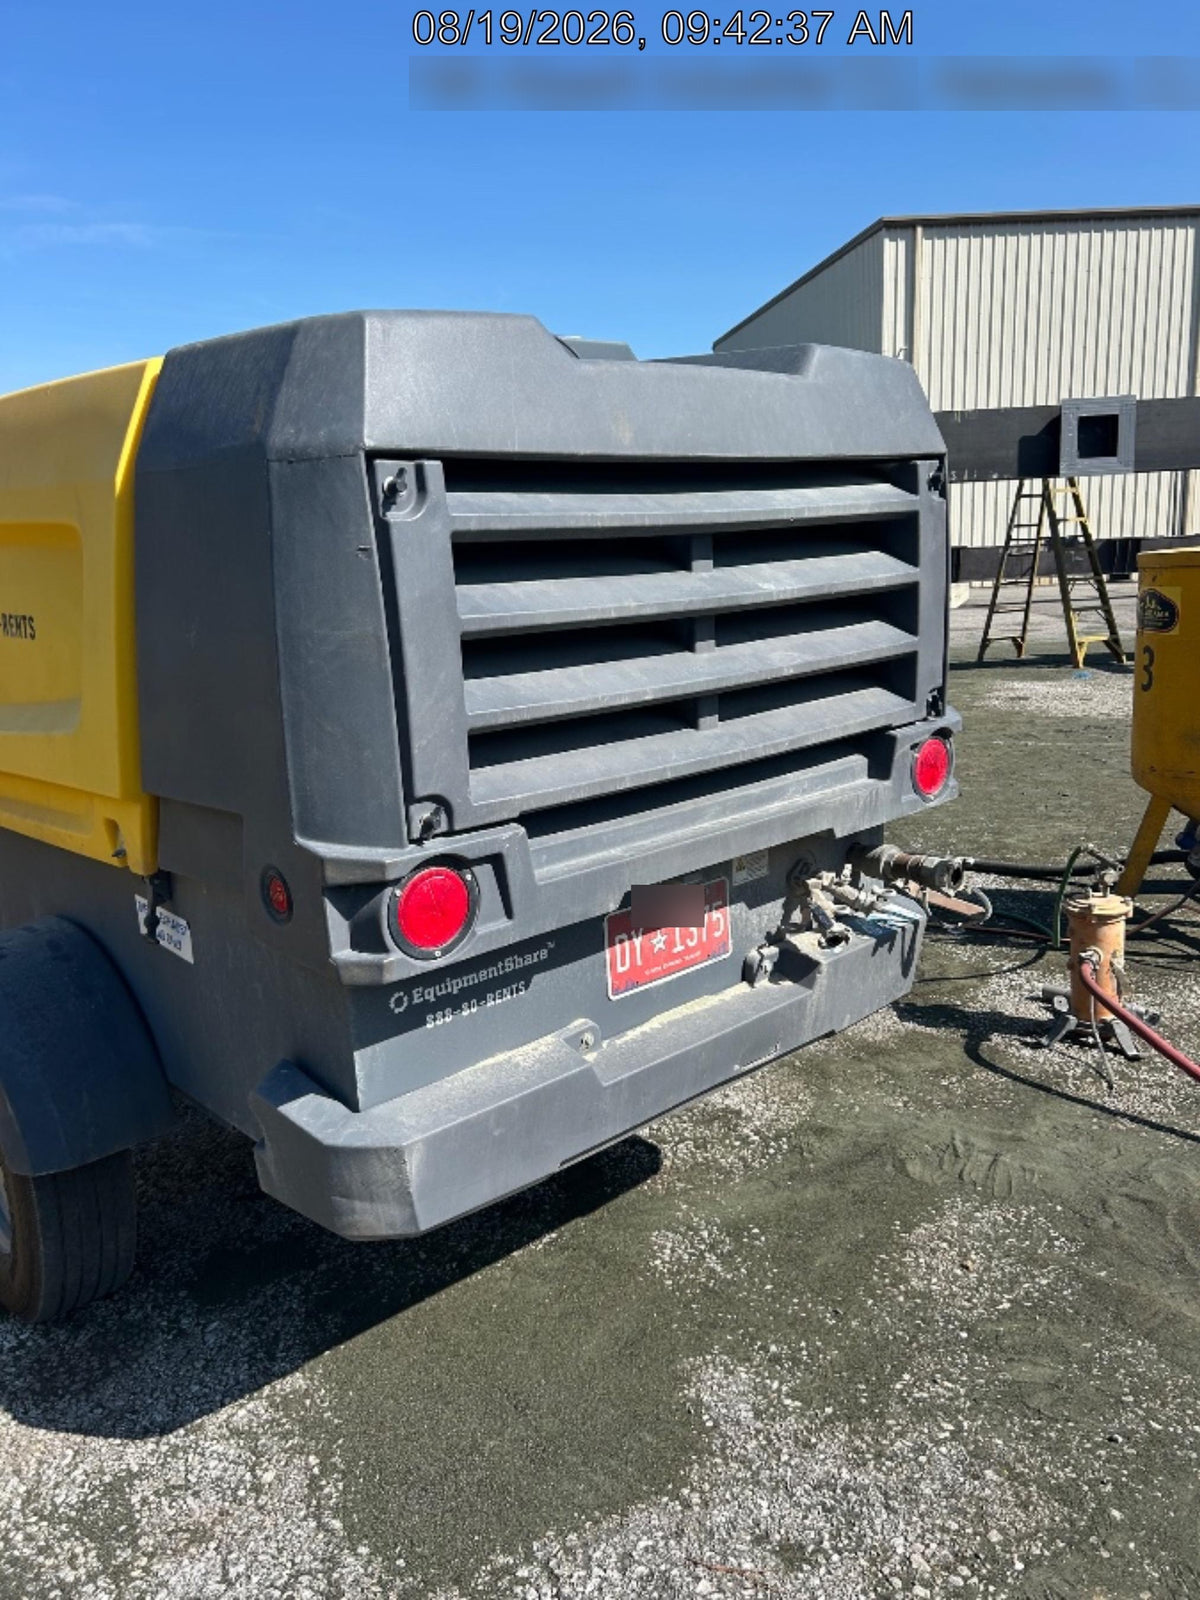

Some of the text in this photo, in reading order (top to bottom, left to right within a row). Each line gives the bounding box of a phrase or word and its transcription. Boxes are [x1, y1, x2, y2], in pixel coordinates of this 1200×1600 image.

[1140, 645, 1155, 692] 3
[614, 926, 644, 974] DY
[425, 981, 526, 1028] 888-80-RENTS
